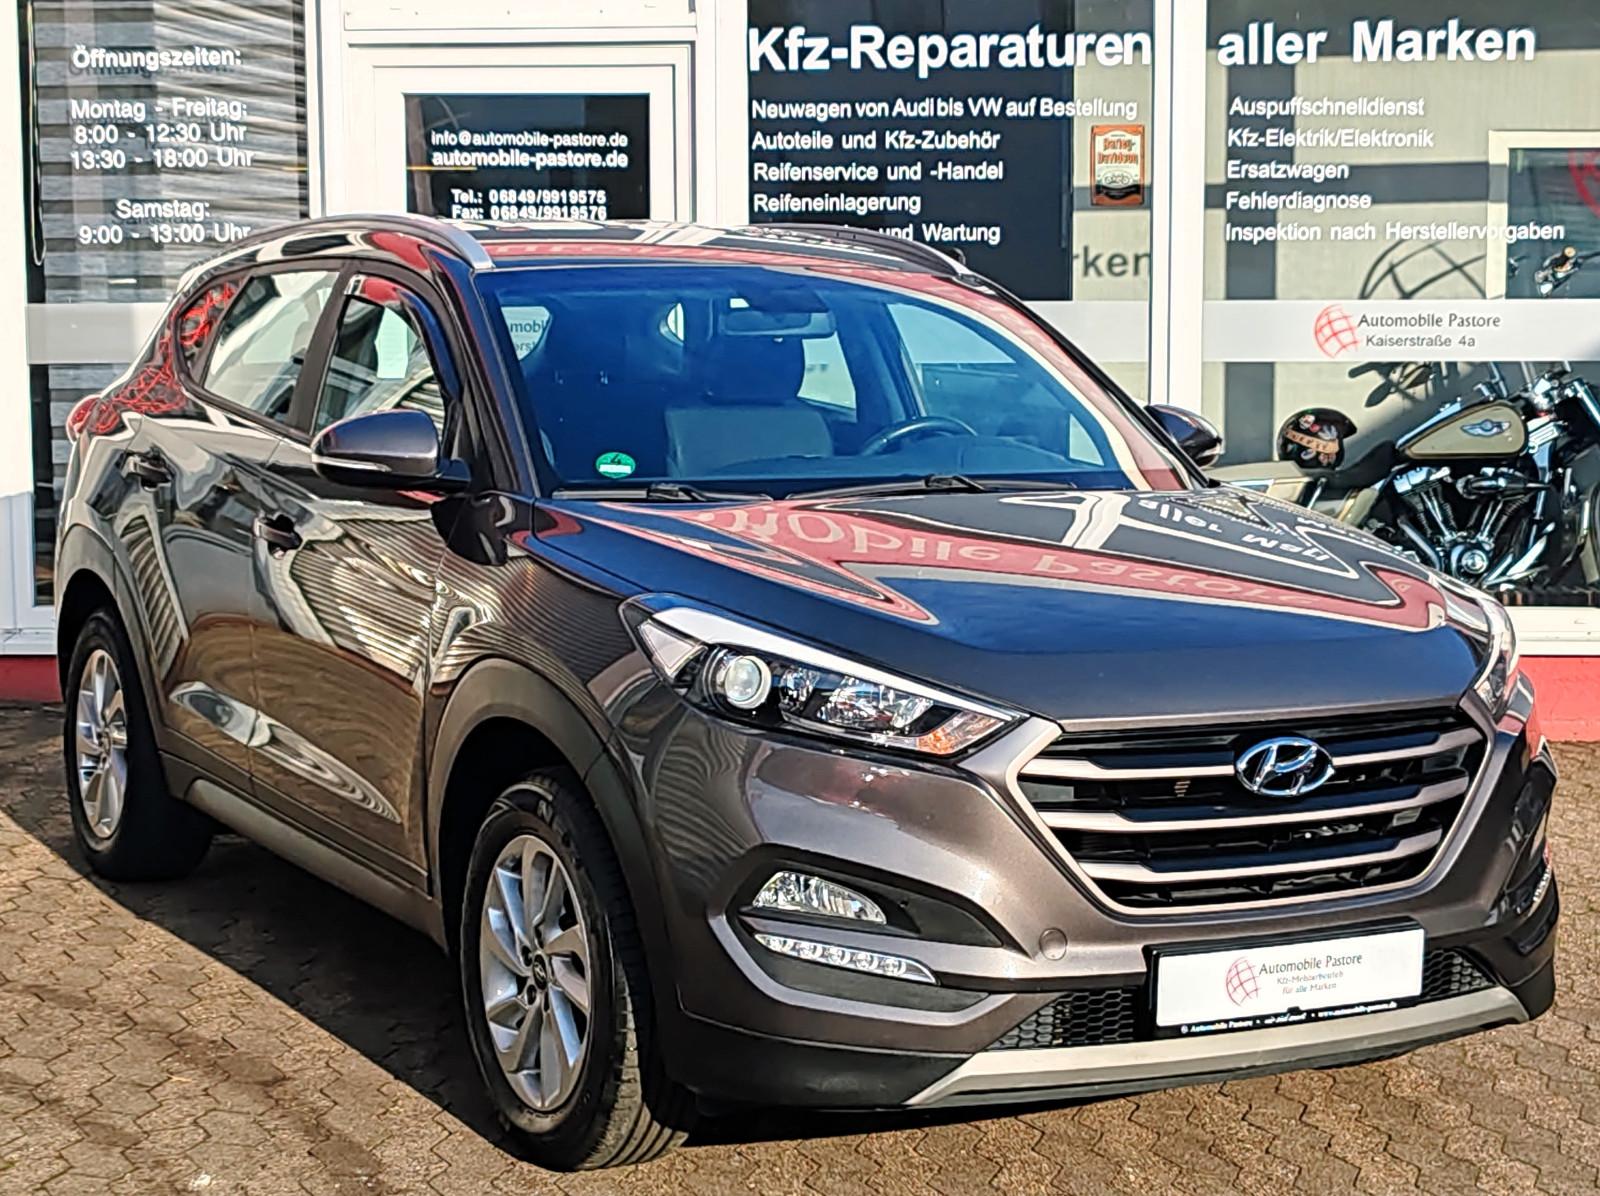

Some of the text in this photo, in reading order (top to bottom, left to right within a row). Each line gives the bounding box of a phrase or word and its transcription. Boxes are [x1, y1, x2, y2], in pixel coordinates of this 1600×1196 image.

[71, 45, 242, 71] Öffnungszeiten:
[748, 17, 1537, 78] Kfz-Reparaturen aller Marken
[71, 99, 147, 123] Montag
[172, 97, 248, 121] Freitag:
[751, 96, 1138, 121] Neuwagen von Audi bis VW auf Bestellung
[1228, 96, 1425, 119] Auspuffschnelldienst
[75, 124, 119, 145] 8:00
[146, 122, 201, 143] 12:30
[210, 122, 248, 142] Uhr
[431, 131, 628, 147] info@automobile-pastore.de
[751, 128, 1001, 151] Autoteile und Kfz-Zubehör
[1227, 127, 1435, 148] Kfz-Elektrik/Elektronik
[71, 151, 126, 170] 13:30
[153, 149, 208, 169] 18:00
[217, 147, 254, 167] Uhr
[431, 148, 629, 170] automobile-pastore.de
[753, 159, 1003, 182] Reifenservice und -Handel
[1227, 159, 1350, 183] Ersatzwagen
[451, 188, 607, 206] Tel.: 06849/9919575
[753, 192, 922, 215] Reifeneinlagerung
[1225, 190, 1372, 212] Fehlerdiagnose
[115, 199, 211, 222] Samstag:
[451, 204, 485, 220] Fax:
[79, 226, 123, 245] 9:00
[151, 223, 206, 243] 13:00
[214, 221, 252, 242] Uhr
[922, 223, 1001, 245] Wartung
[1225, 220, 1565, 244] Inspektion nach Herstellervorgaben
[1358, 311, 1501, 329] Automobile Pastore
[1366, 334, 1476, 349] Kaiserstraße 4a
[1259, 953, 1363, 977] Automobile Pastore
